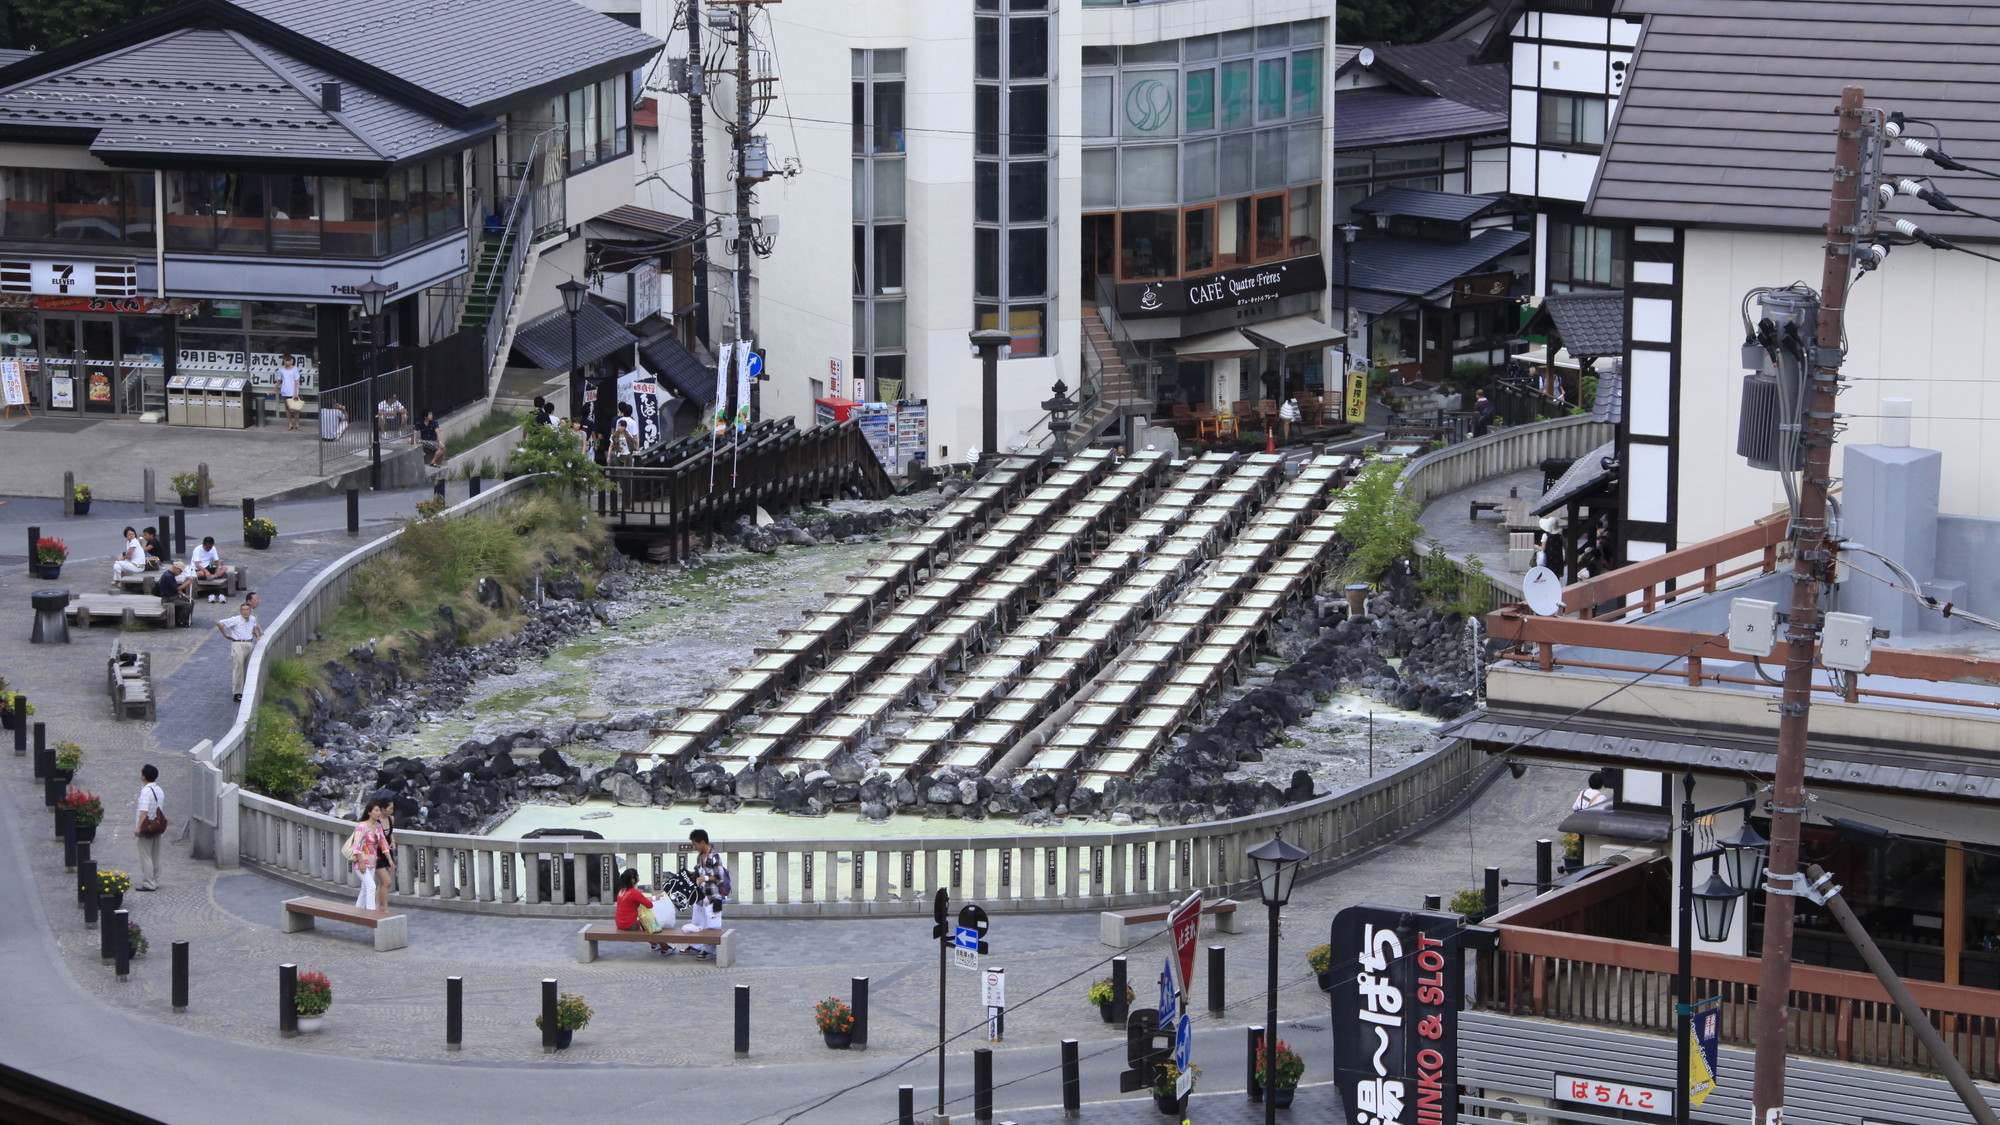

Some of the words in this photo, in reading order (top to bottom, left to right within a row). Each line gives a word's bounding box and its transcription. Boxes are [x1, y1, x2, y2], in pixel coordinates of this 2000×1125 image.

[1190, 276, 1224, 304] CAFÉ
[1229, 278, 1256, 296] Quatre
[1256, 271, 1281, 287] Frères
[1177, 920, 1197, 950] 止まれ
[1417, 931, 1445, 1005] SLOT
[1417, 1013, 1443, 1040] &
[1571, 1080, 1655, 1109] ぱちんこ
